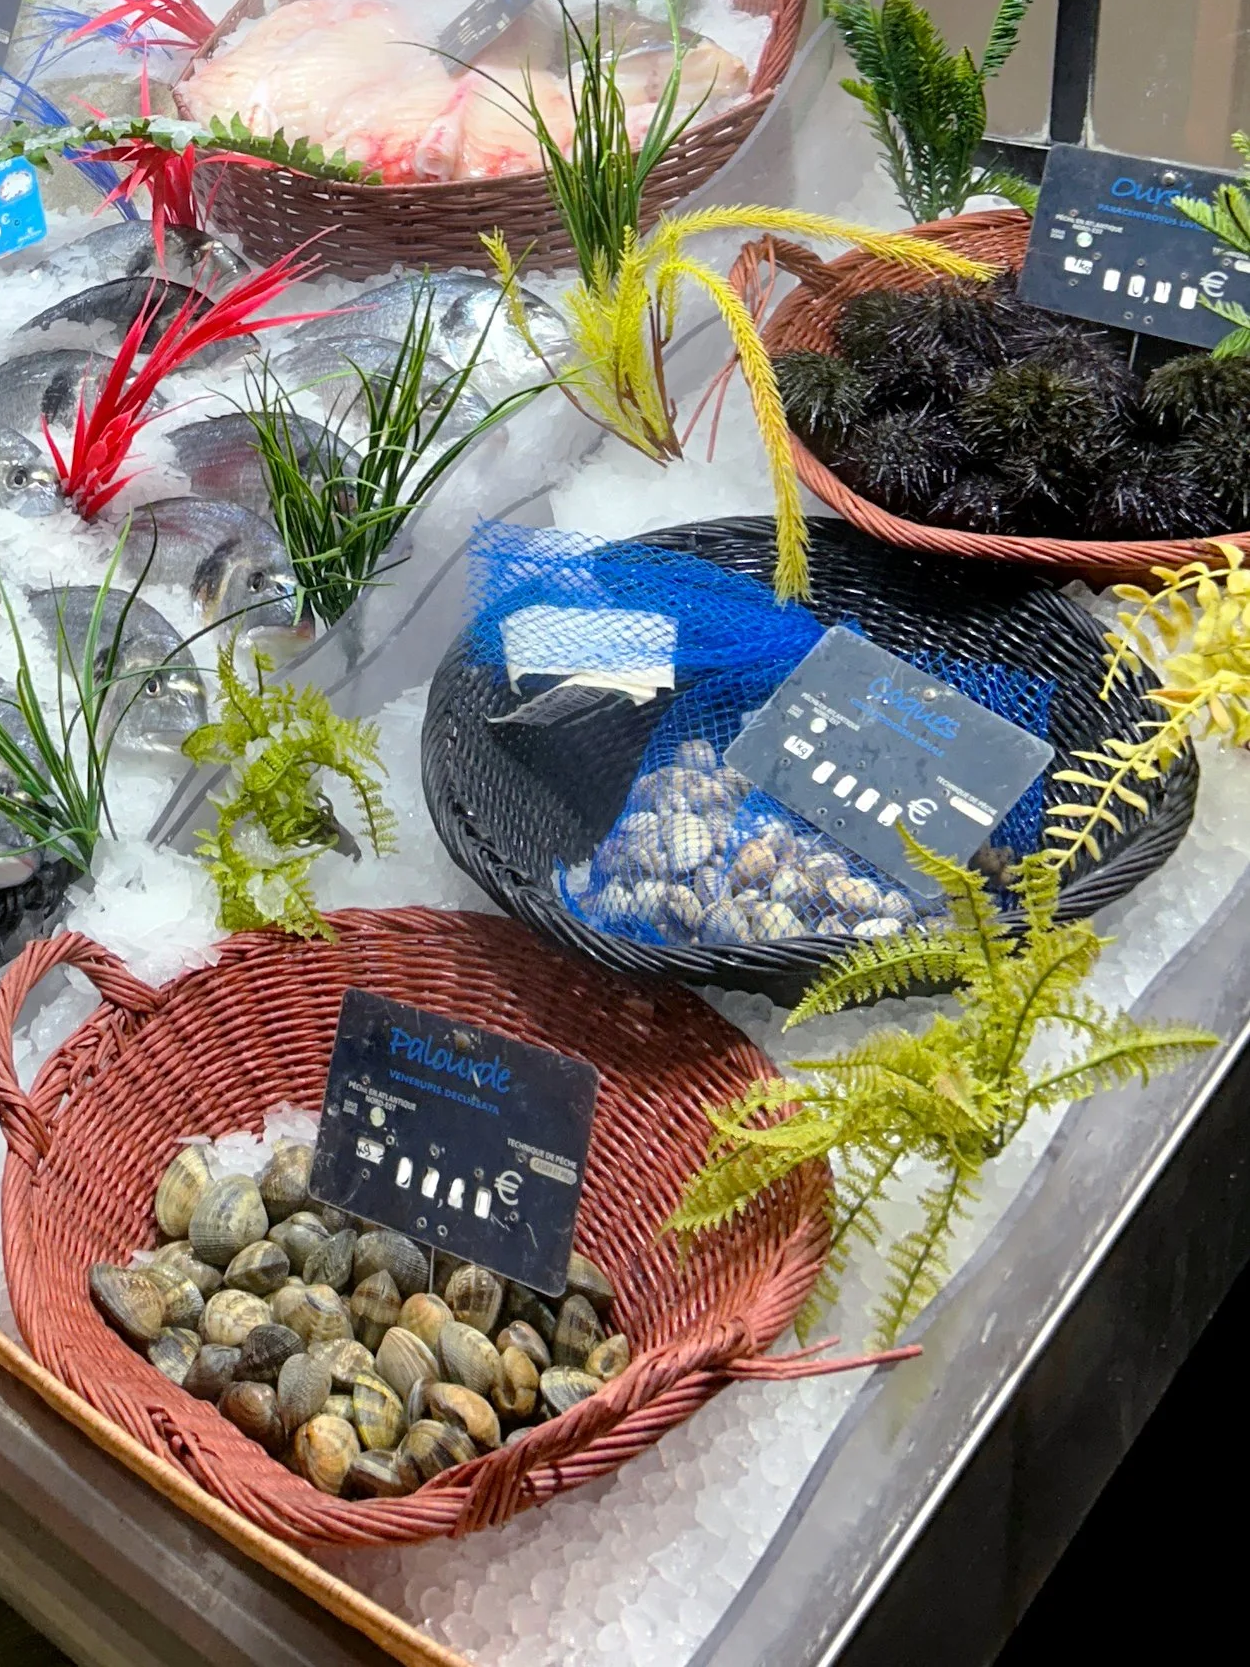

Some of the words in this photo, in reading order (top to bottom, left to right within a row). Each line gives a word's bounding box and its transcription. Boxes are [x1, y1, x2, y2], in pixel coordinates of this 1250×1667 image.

[1199, 271, 1228, 298] €
[868, 676, 960, 741] Coques
[907, 797, 938, 825] €
[389, 1026, 511, 1095] Palourde
[493, 1169, 524, 1206] €
